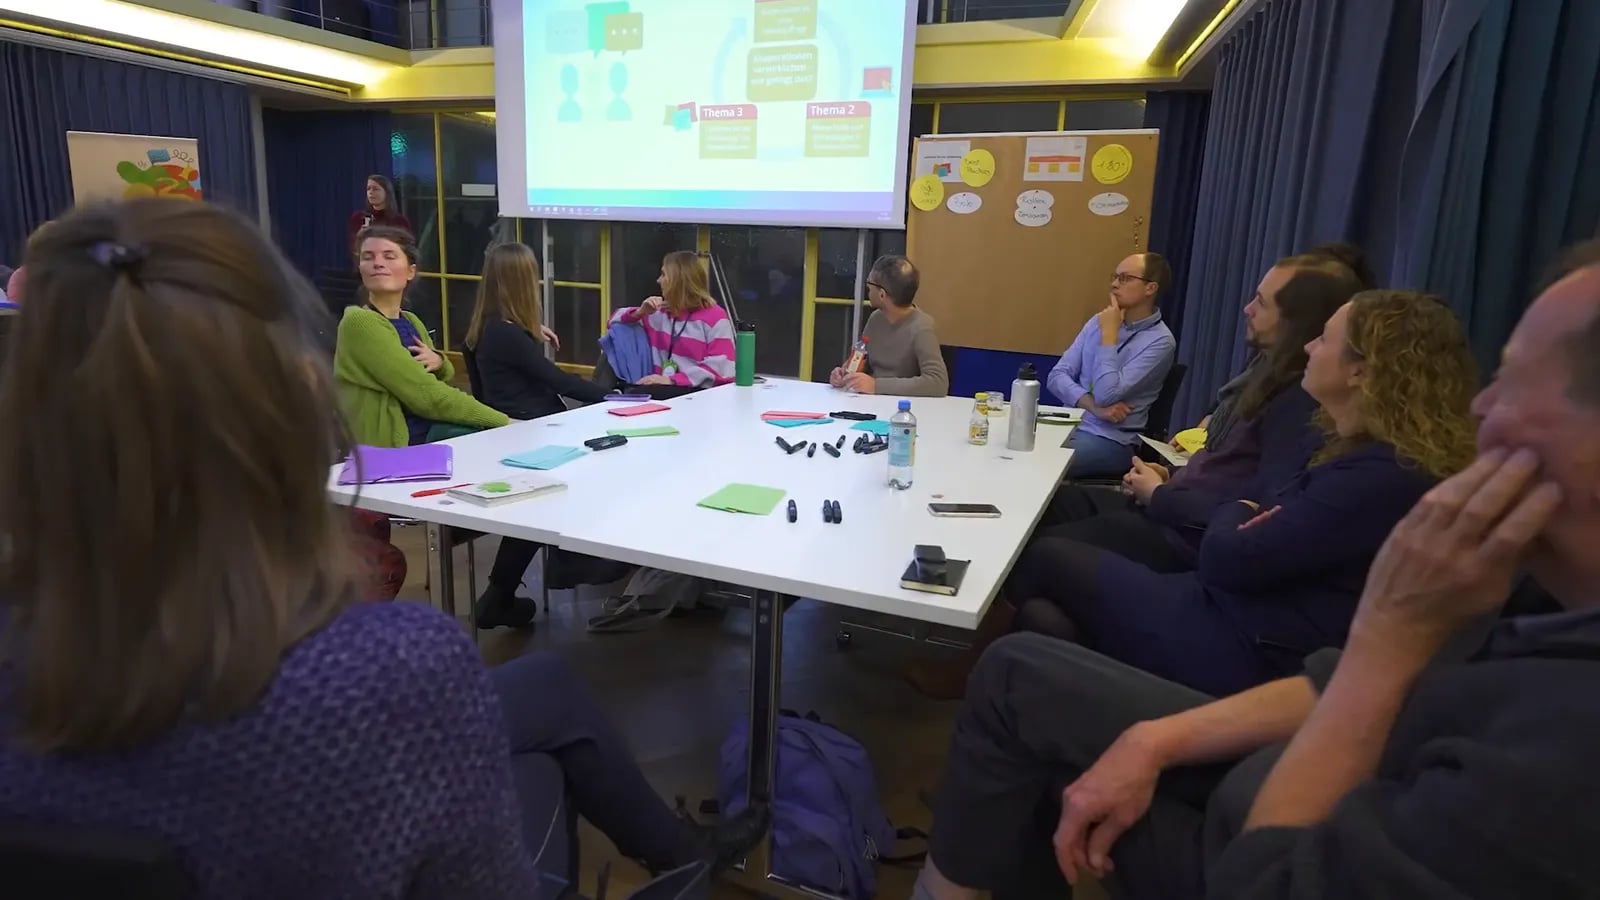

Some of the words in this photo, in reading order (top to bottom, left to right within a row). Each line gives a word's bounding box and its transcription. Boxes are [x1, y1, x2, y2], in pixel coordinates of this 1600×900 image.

[703, 108, 735, 118] Thema
[737, 108, 743, 117] 3
[810, 105, 846, 116] Thema
[848, 104, 855, 115] 2
